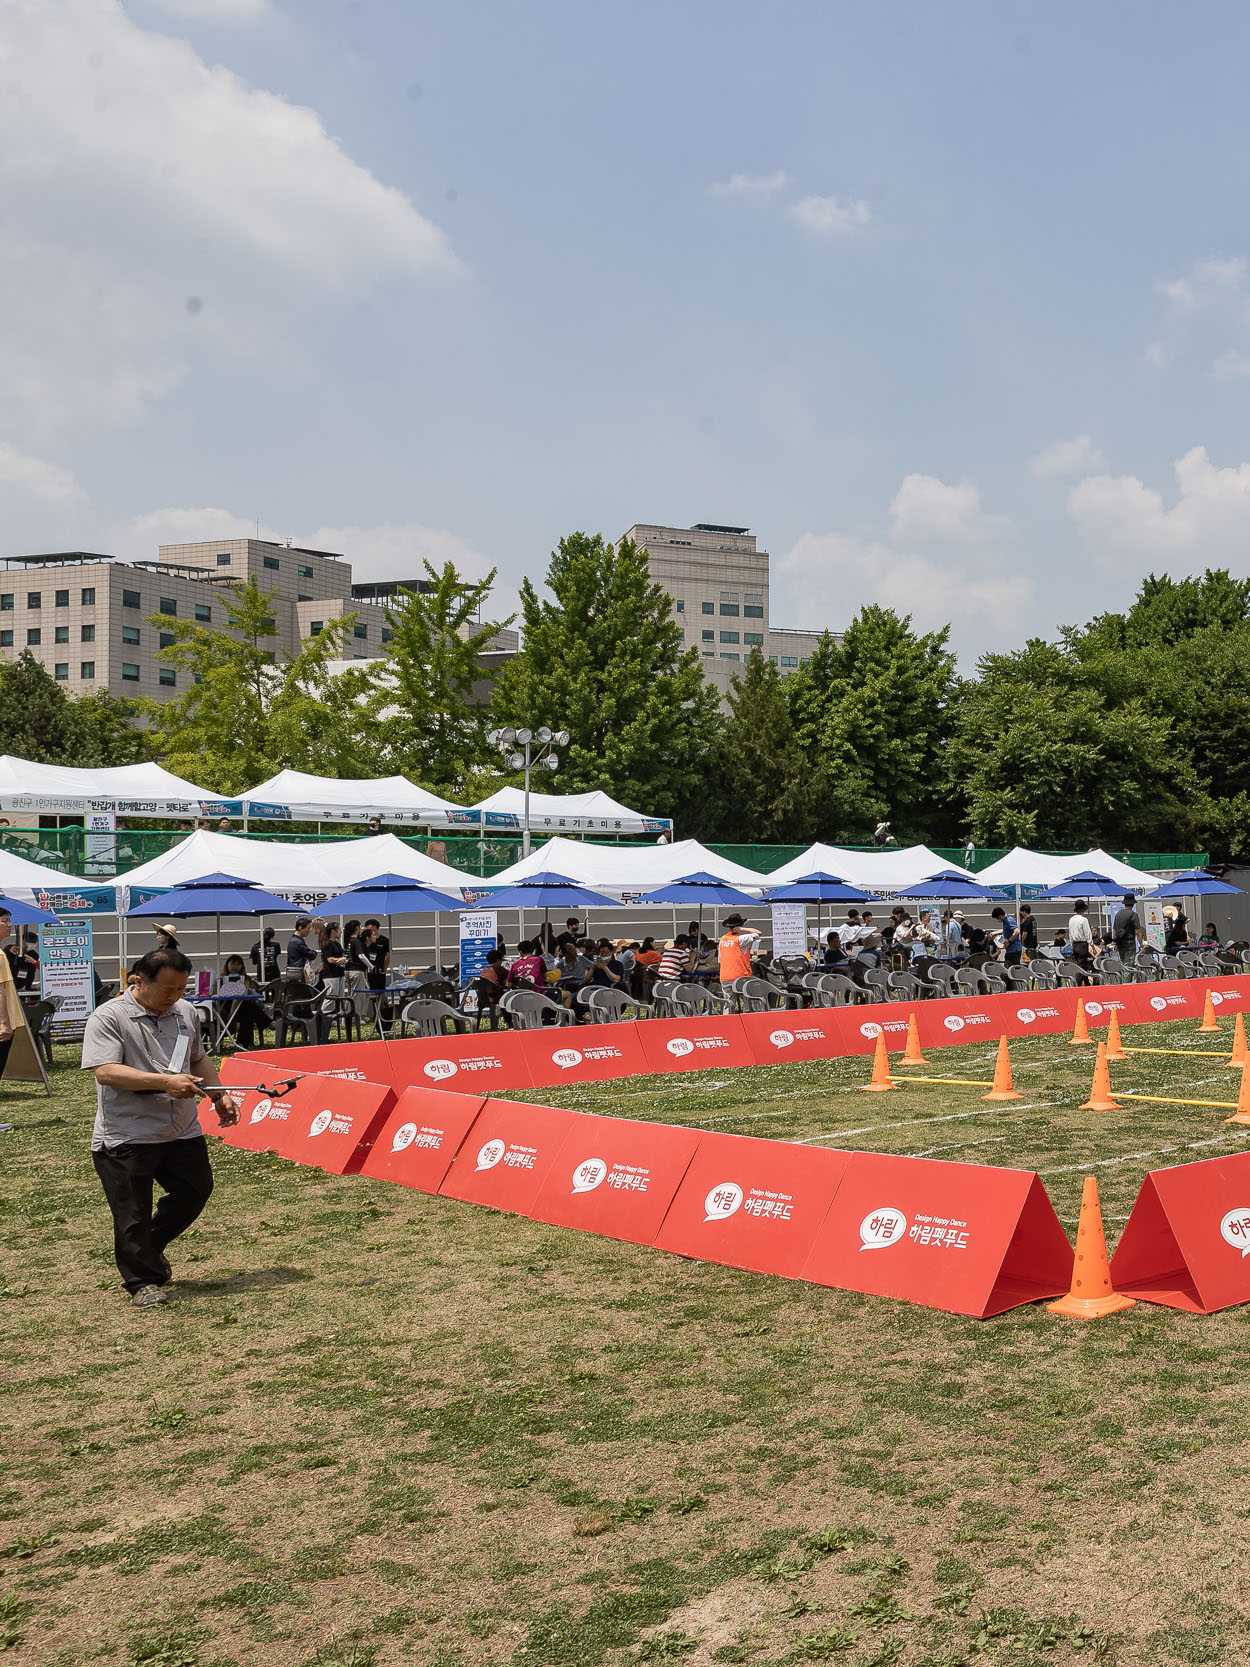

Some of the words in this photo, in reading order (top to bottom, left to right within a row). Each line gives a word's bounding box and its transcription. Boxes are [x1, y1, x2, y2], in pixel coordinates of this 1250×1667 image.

[12, 798, 33, 808] 광진구
[465, 921, 492, 929] 추억사진
[468, 929, 489, 937] 꾸미기
[43, 936, 89, 948] 로프토이
[49, 948, 84, 960] 만들기
[695, 1039, 730, 1049] 하림펫푸드
[775, 1033, 789, 1043] 하림
[672, 1042, 688, 1050] 하림
[557, 1052, 576, 1062] 하림
[584, 1049, 622, 1060] 하림펫푸드
[430, 1062, 450, 1074] 하림
[460, 1059, 503, 1072] 하림펫푸드
[483, 1146, 500, 1162] 하림
[504, 1151, 537, 1169] 하림펫푸드
[581, 1165, 601, 1184] 하림
[613, 1163, 625, 1171] Design
[625, 1165, 637, 1174] Happy
[606, 1171, 651, 1192] 하림펫푸드
[713, 1190, 737, 1210] 하림
[749, 1188, 764, 1197] Design
[764, 1190, 778, 1199] Happy
[778, 1192, 793, 1200] Dance
[744, 1197, 794, 1220] 하림펫푸드
[914, 1213, 932, 1224] Design
[932, 1216, 950, 1226] Happy
[949, 1218, 967, 1228] Dance
[870, 1216, 898, 1239] 하림
[909, 1223, 970, 1249] 하림펫푸드
